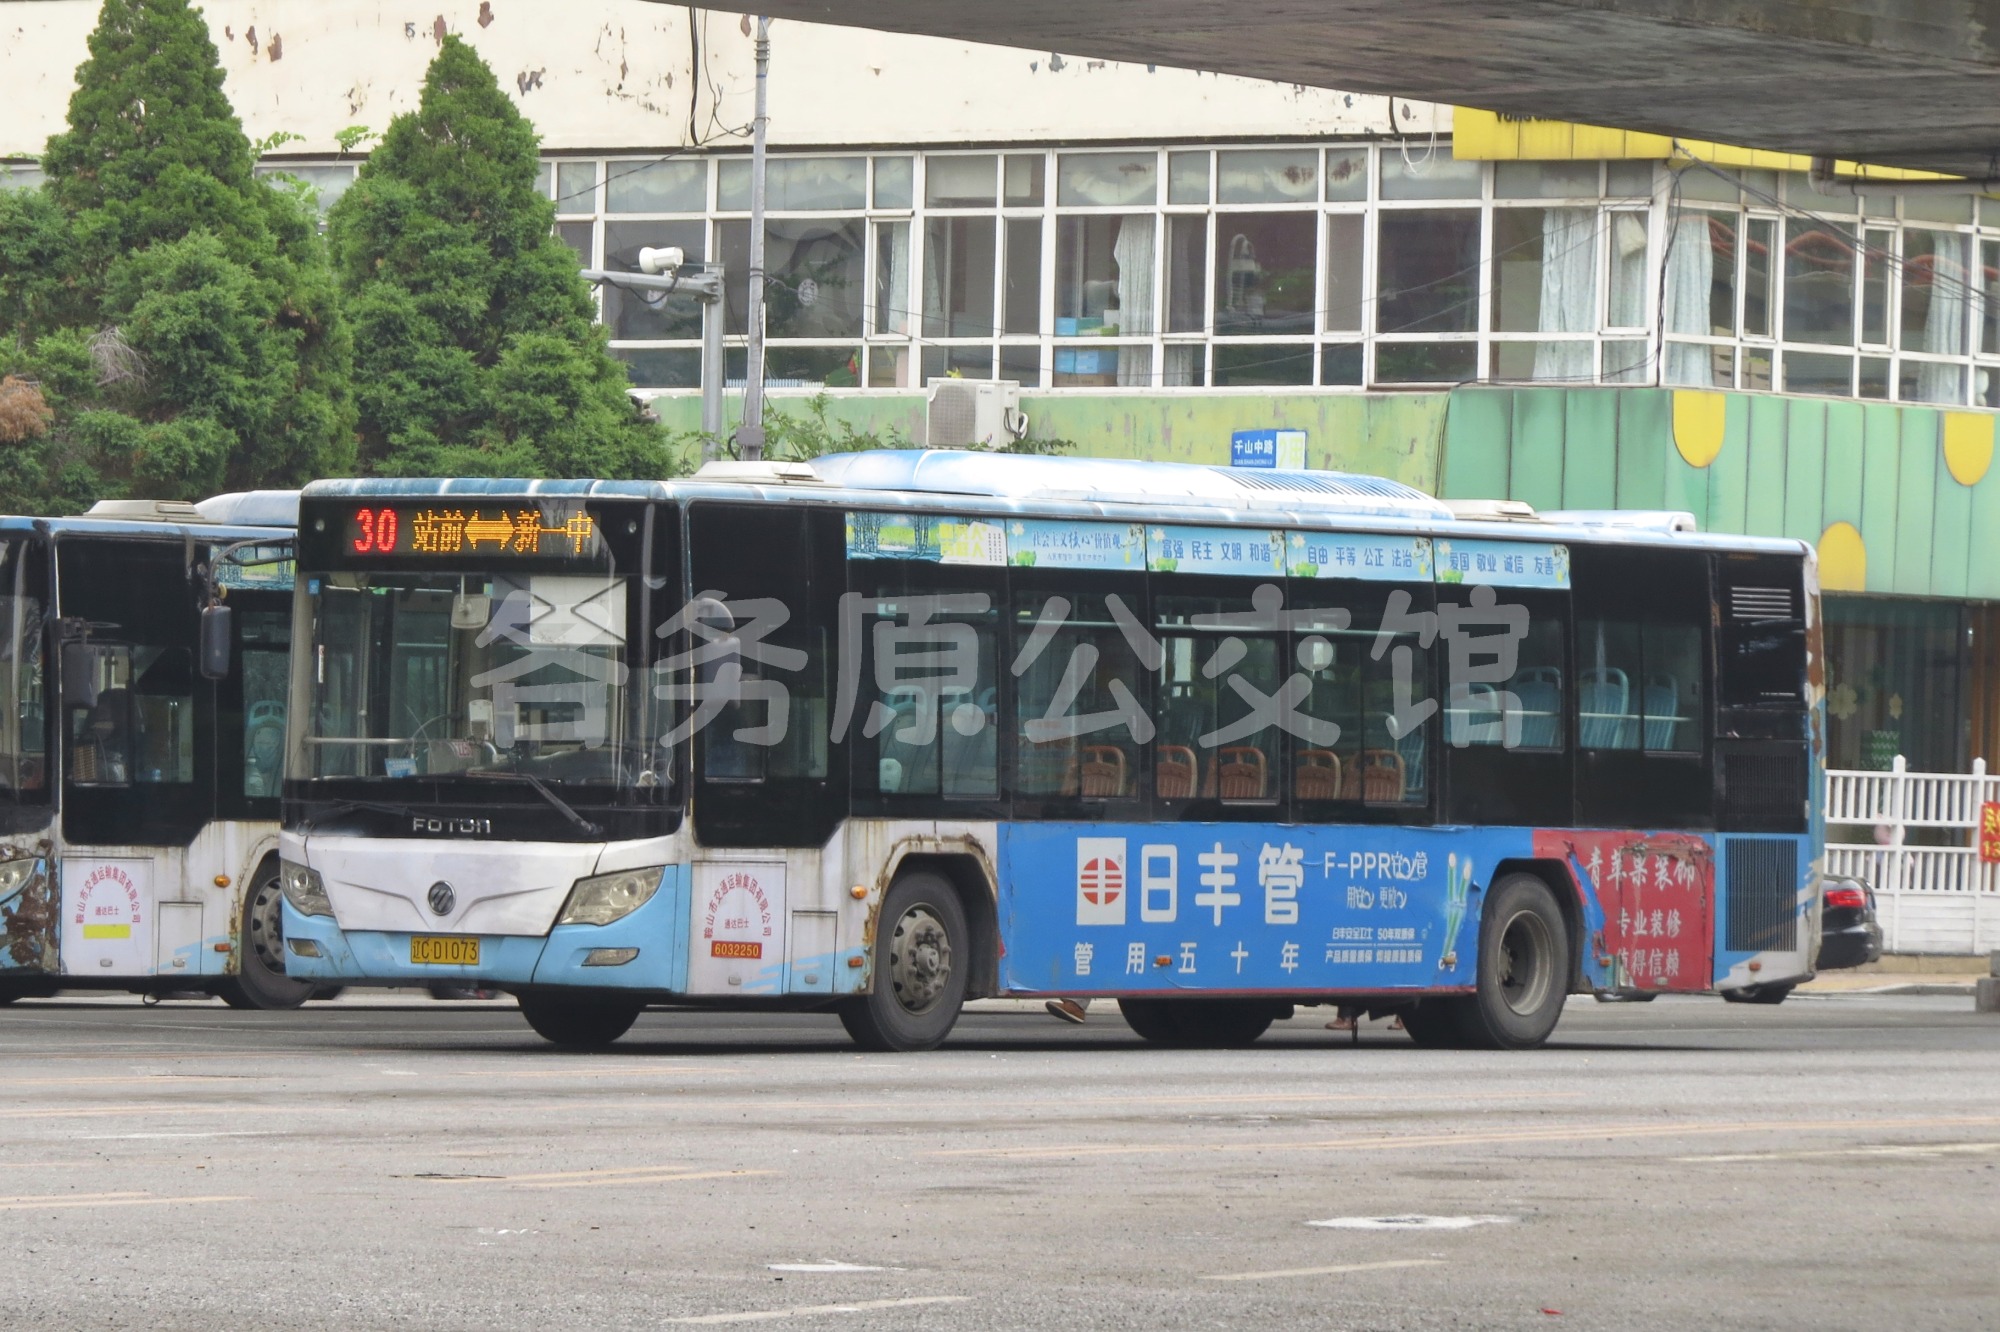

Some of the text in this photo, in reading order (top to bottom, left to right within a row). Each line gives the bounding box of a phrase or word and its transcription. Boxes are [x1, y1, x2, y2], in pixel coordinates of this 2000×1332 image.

[1234, 439, 1273, 455] 千山中路
[354, 509, 396, 551] 30
[1162, 539, 1271, 562] 富强 民主 文明 和谐
[1307, 545, 1412, 568] 自由 平等 公正 法治
[1449, 551, 1554, 576] 爱国 敬业 诚信 友善
[412, 816, 491, 833] FOTON
[1585, 843, 1696, 892] 青苹果装饰
[1140, 841, 1305, 927] 日丰管
[704, 872, 772, 939] 鞍山市交通运输集团有限公司
[724, 917, 750, 930] 通达巴士
[1616, 907, 1682, 938] 专业装修
[714, 942, 759, 957] 6032250
[1074, 941, 1300, 977] 管用五十年
